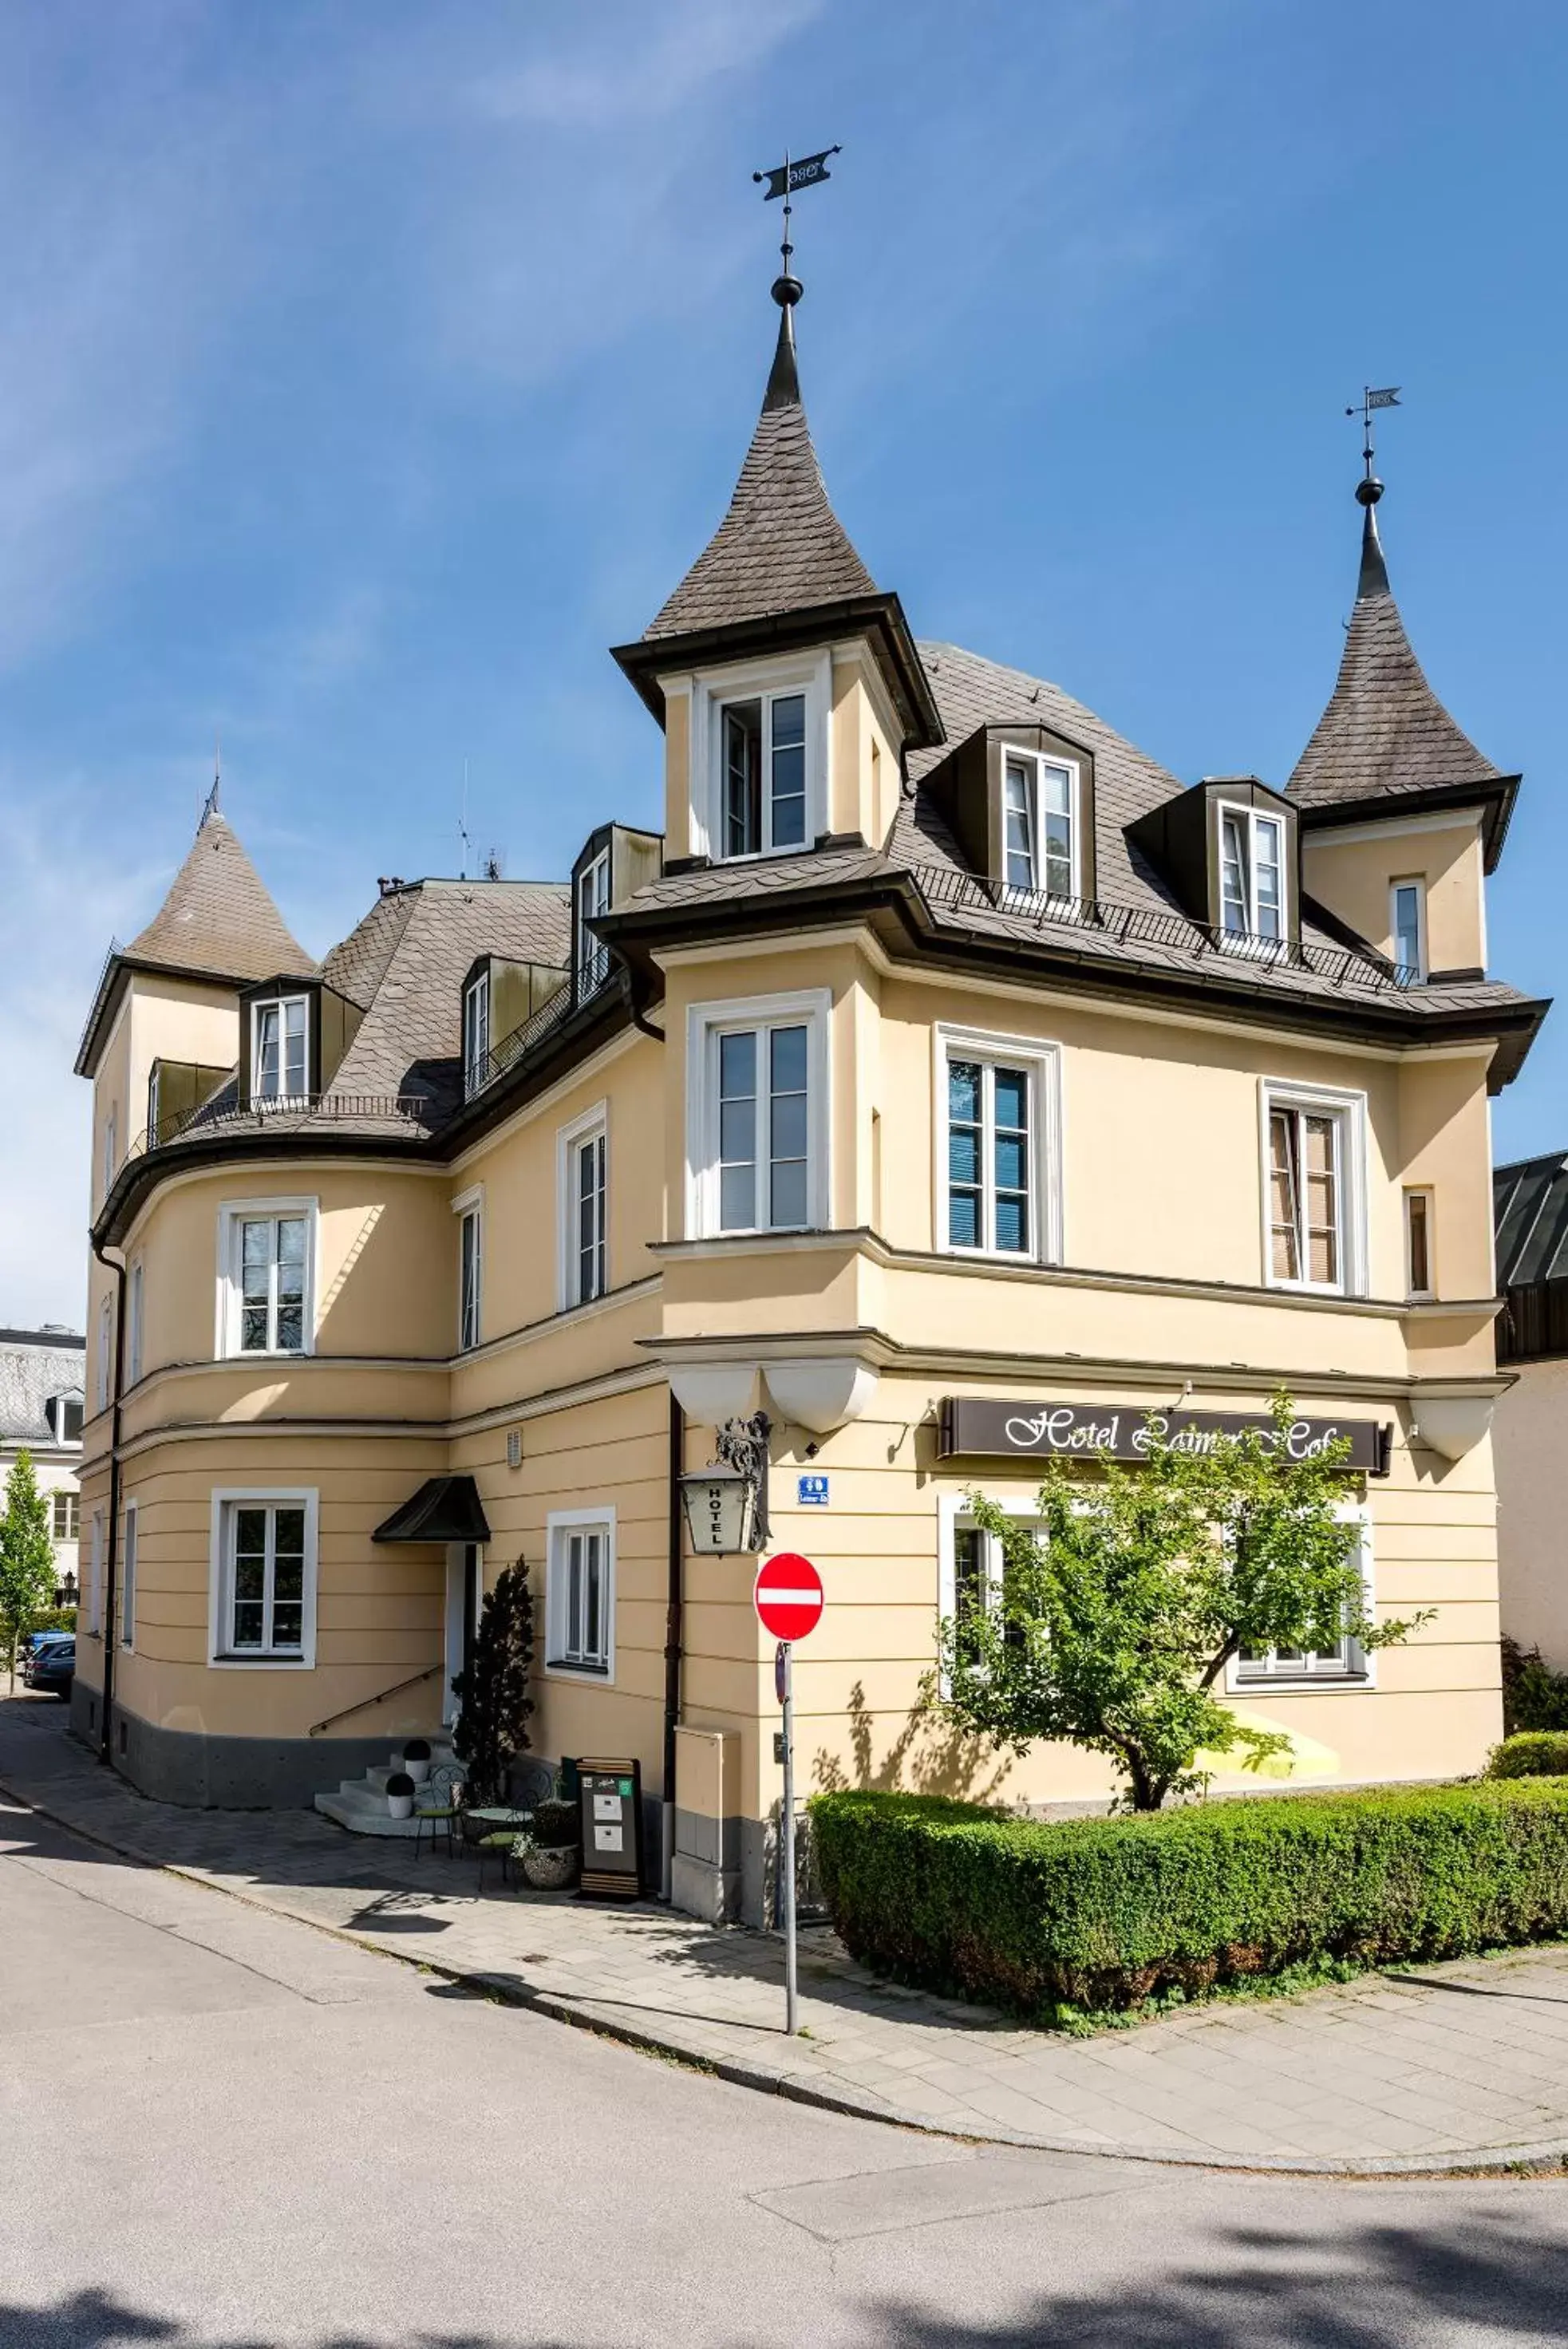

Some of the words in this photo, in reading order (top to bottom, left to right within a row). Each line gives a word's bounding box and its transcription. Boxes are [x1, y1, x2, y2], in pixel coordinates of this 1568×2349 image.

[1005, 1409, 1120, 1450] Hotel
[1132, 1417, 1242, 1455] Laimr
[709, 1488, 722, 1545] HOTEL
